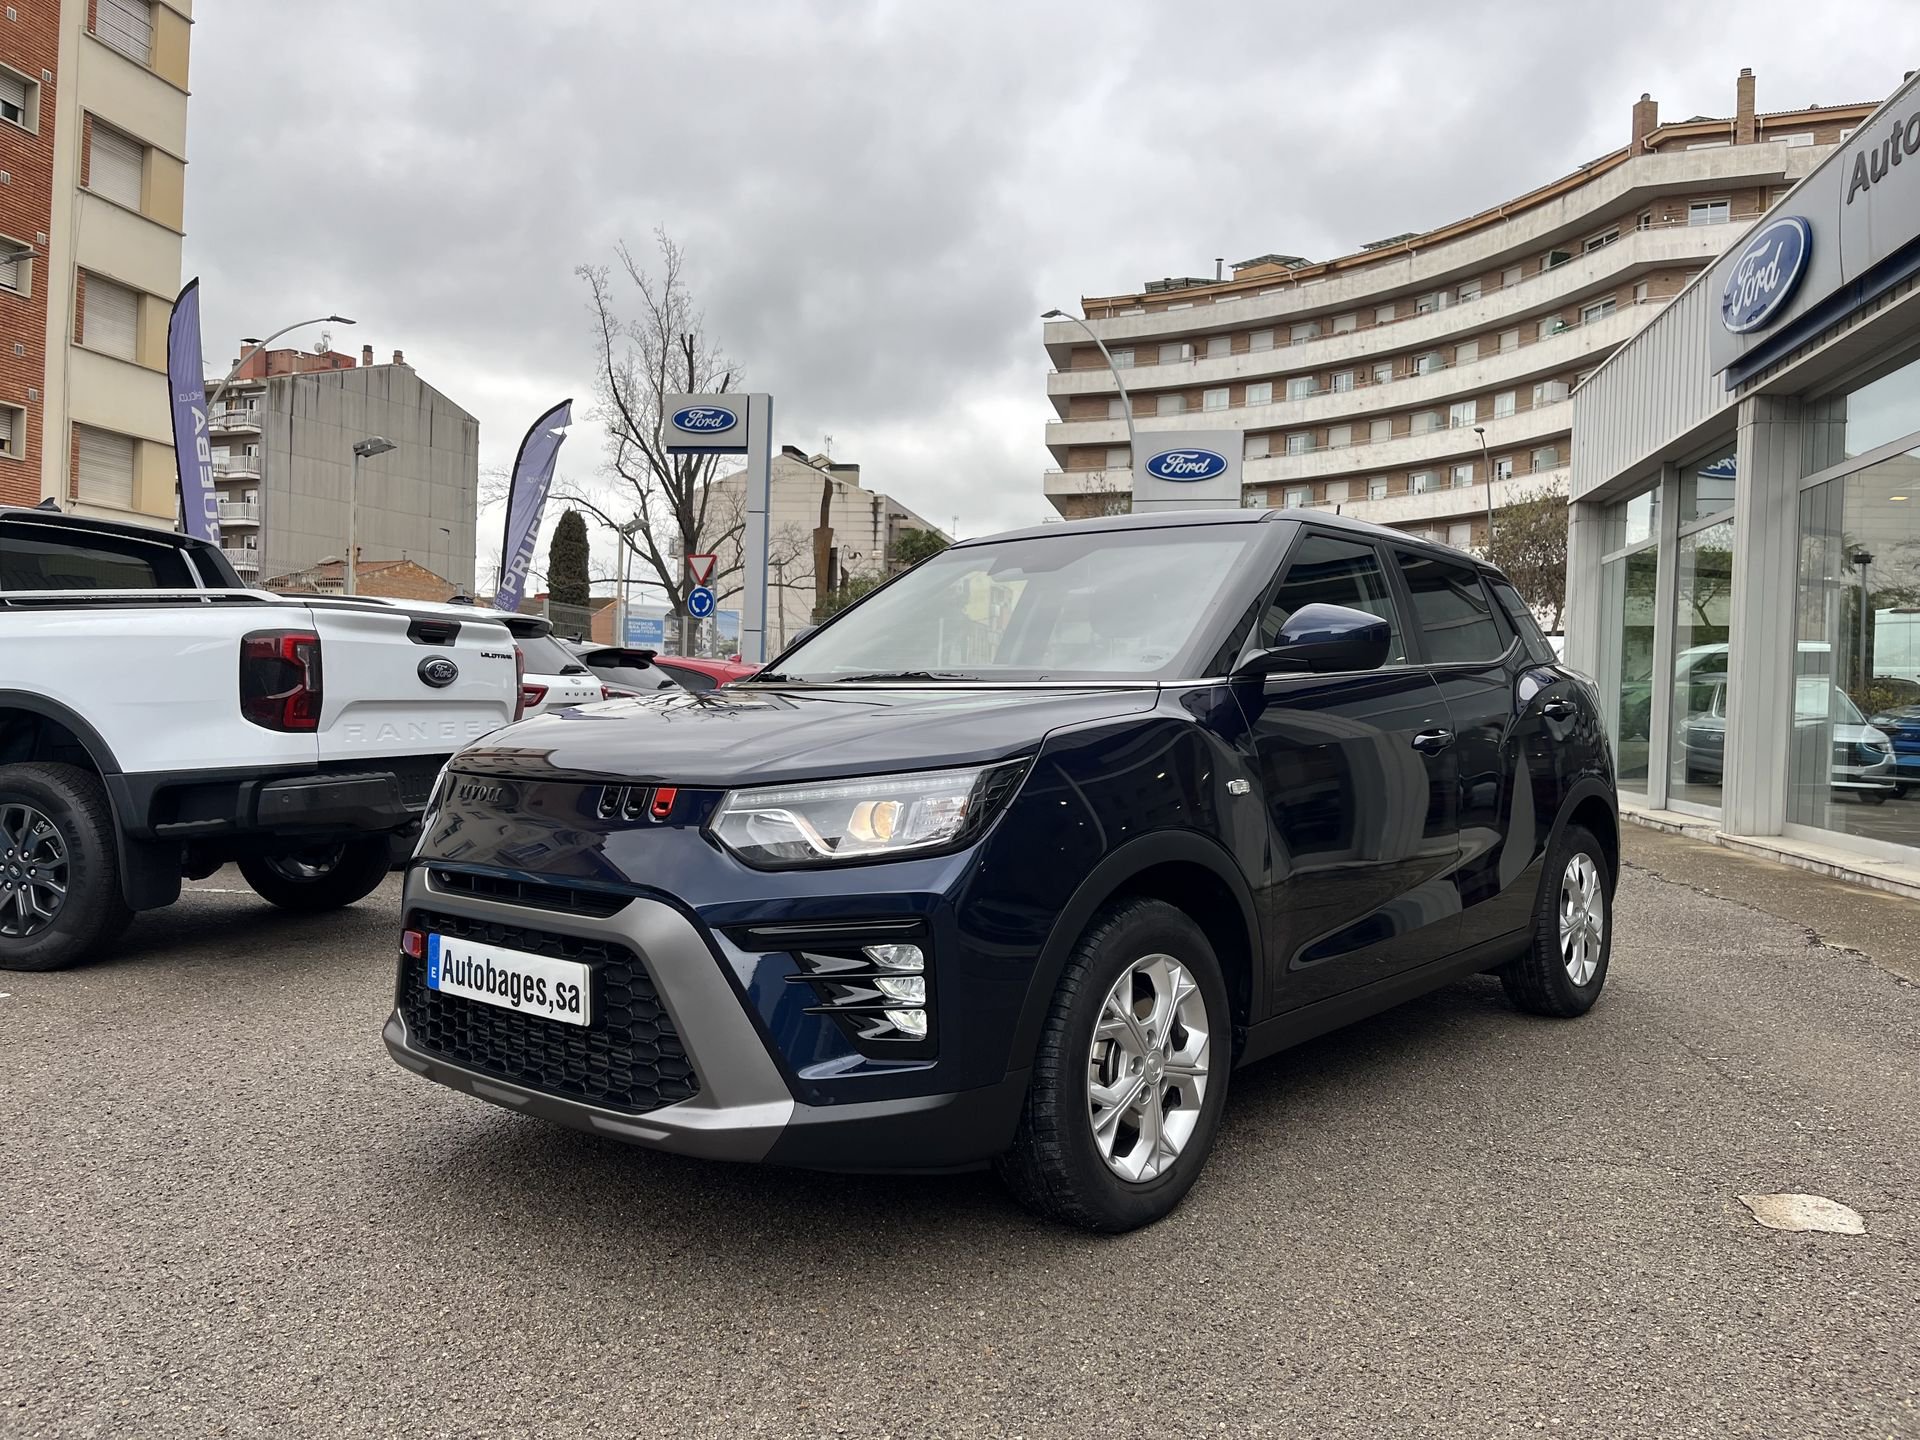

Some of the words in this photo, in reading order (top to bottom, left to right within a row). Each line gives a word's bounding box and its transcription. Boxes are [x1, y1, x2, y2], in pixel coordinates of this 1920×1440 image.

[1732, 239, 1784, 317] Ford
[684, 409, 725, 427] Ford
[1161, 453, 1211, 474] Ford
[458, 783, 504, 802] TIVOLI
[431, 967, 437, 978] E
[441, 949, 581, 1014] Autobages,sa
